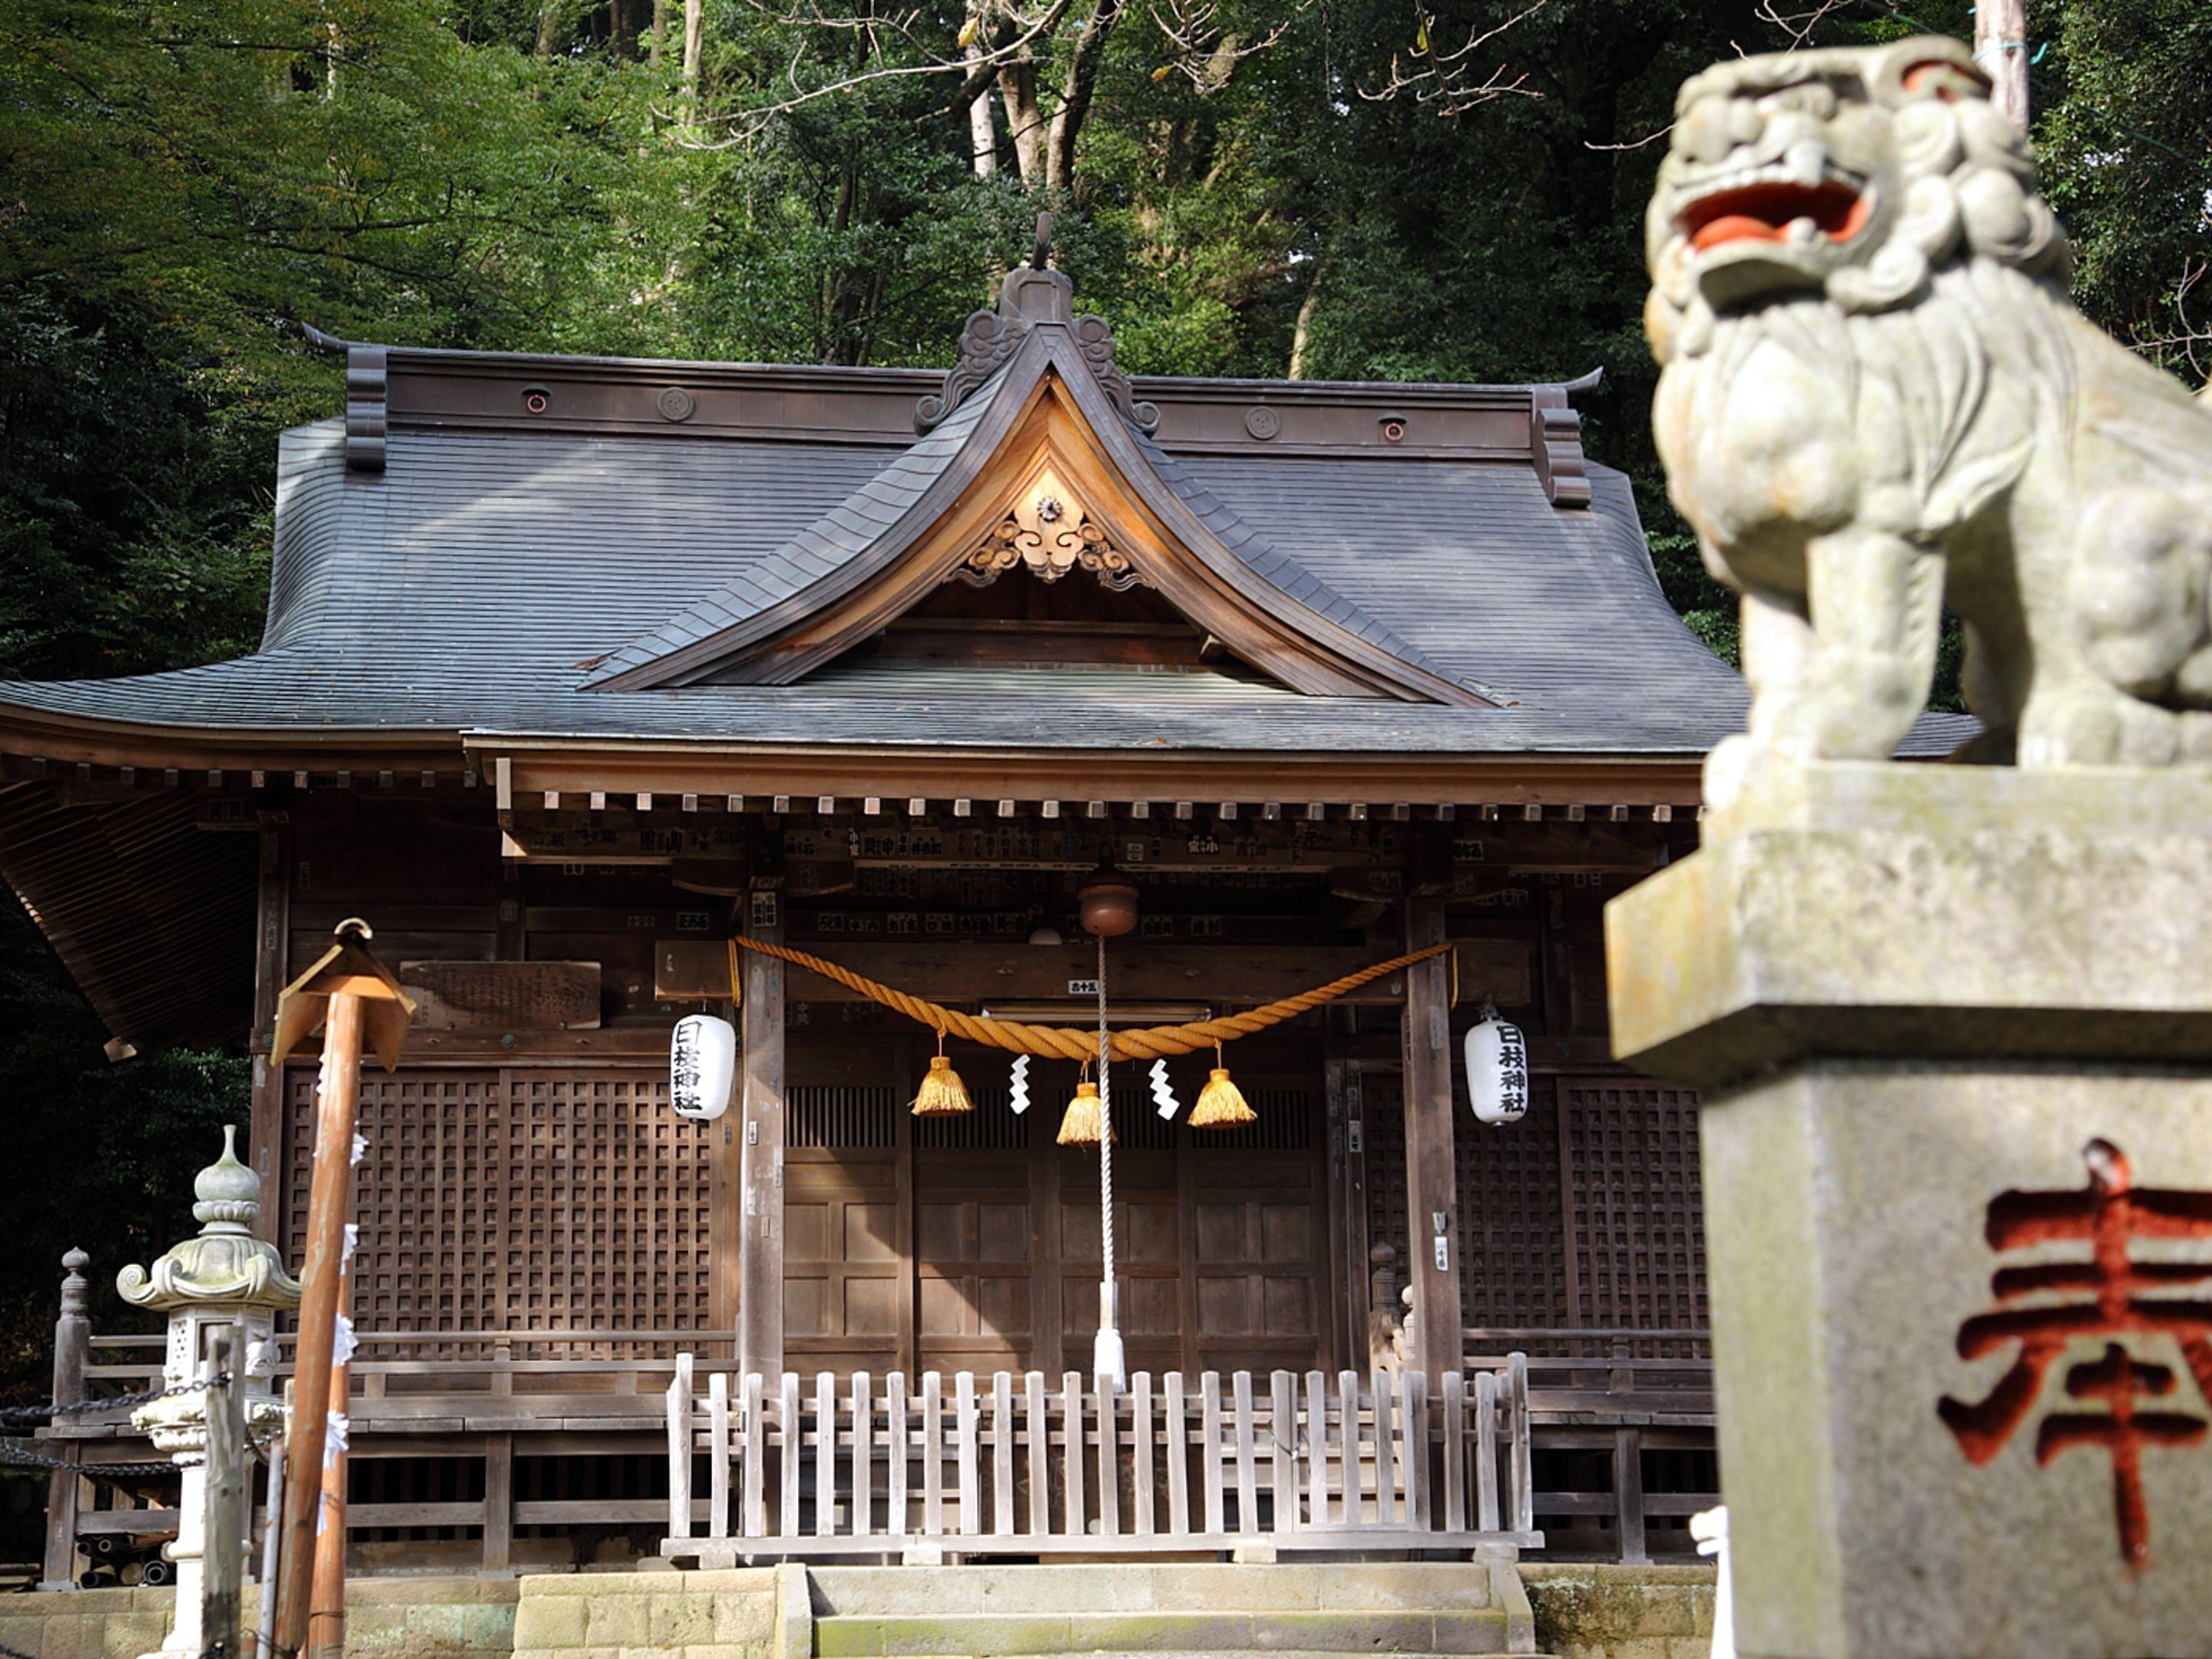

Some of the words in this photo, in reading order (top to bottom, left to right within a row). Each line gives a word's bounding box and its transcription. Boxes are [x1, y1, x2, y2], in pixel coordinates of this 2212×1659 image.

[673, 1021, 703, 1111] 日枝神社
[1496, 1025, 1525, 1113] 日枝神社
